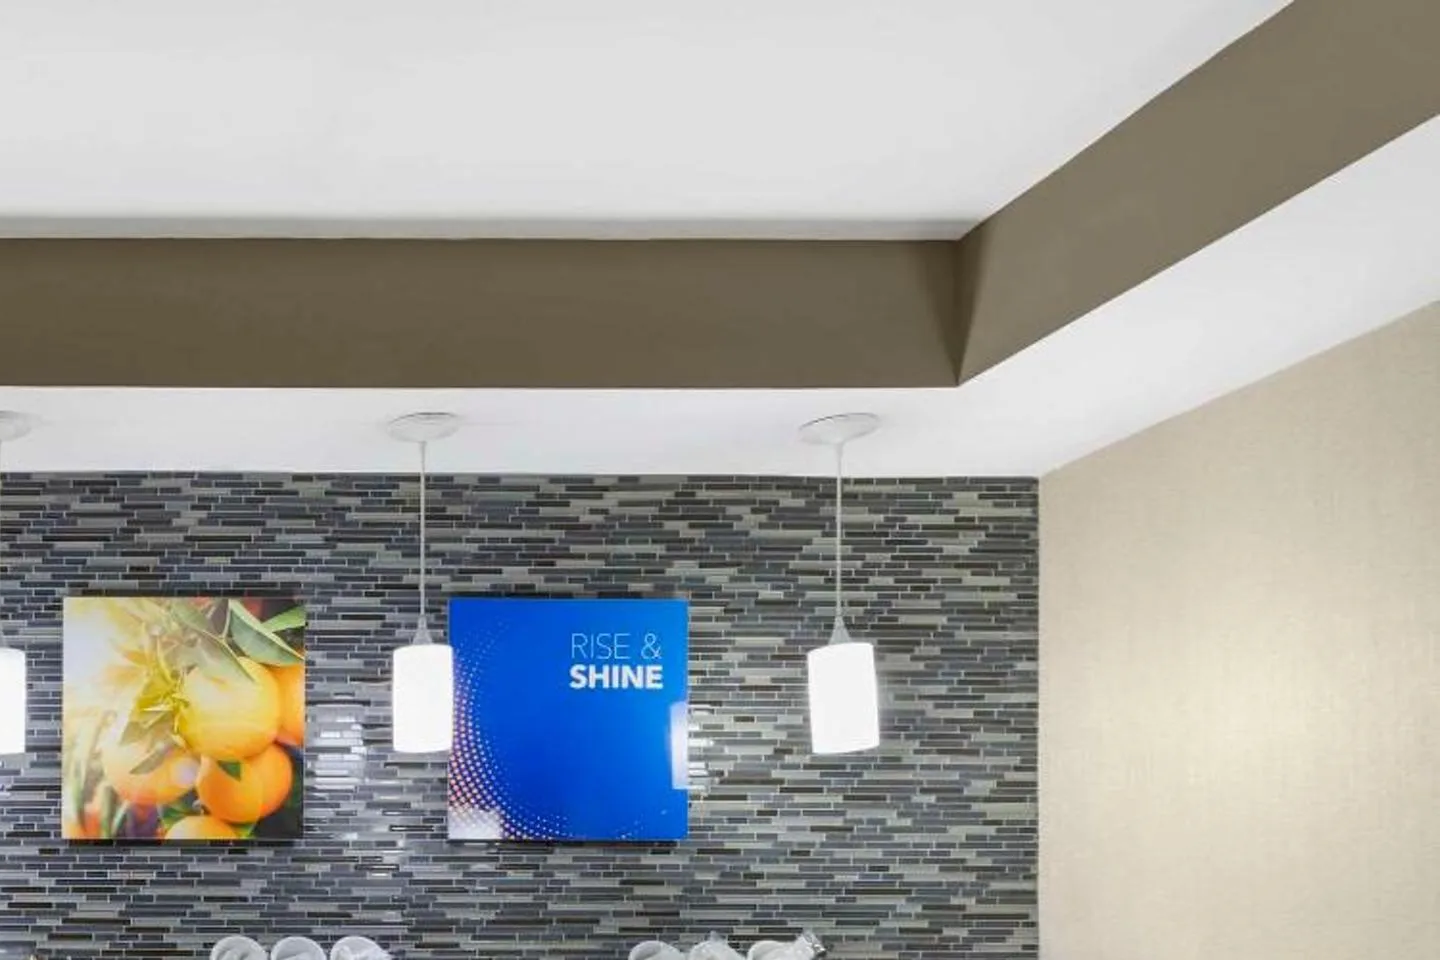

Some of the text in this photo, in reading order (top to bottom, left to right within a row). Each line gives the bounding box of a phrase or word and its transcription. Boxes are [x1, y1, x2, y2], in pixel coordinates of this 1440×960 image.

[571, 632, 662, 660] RISE &
[569, 664, 664, 690] SHINE
